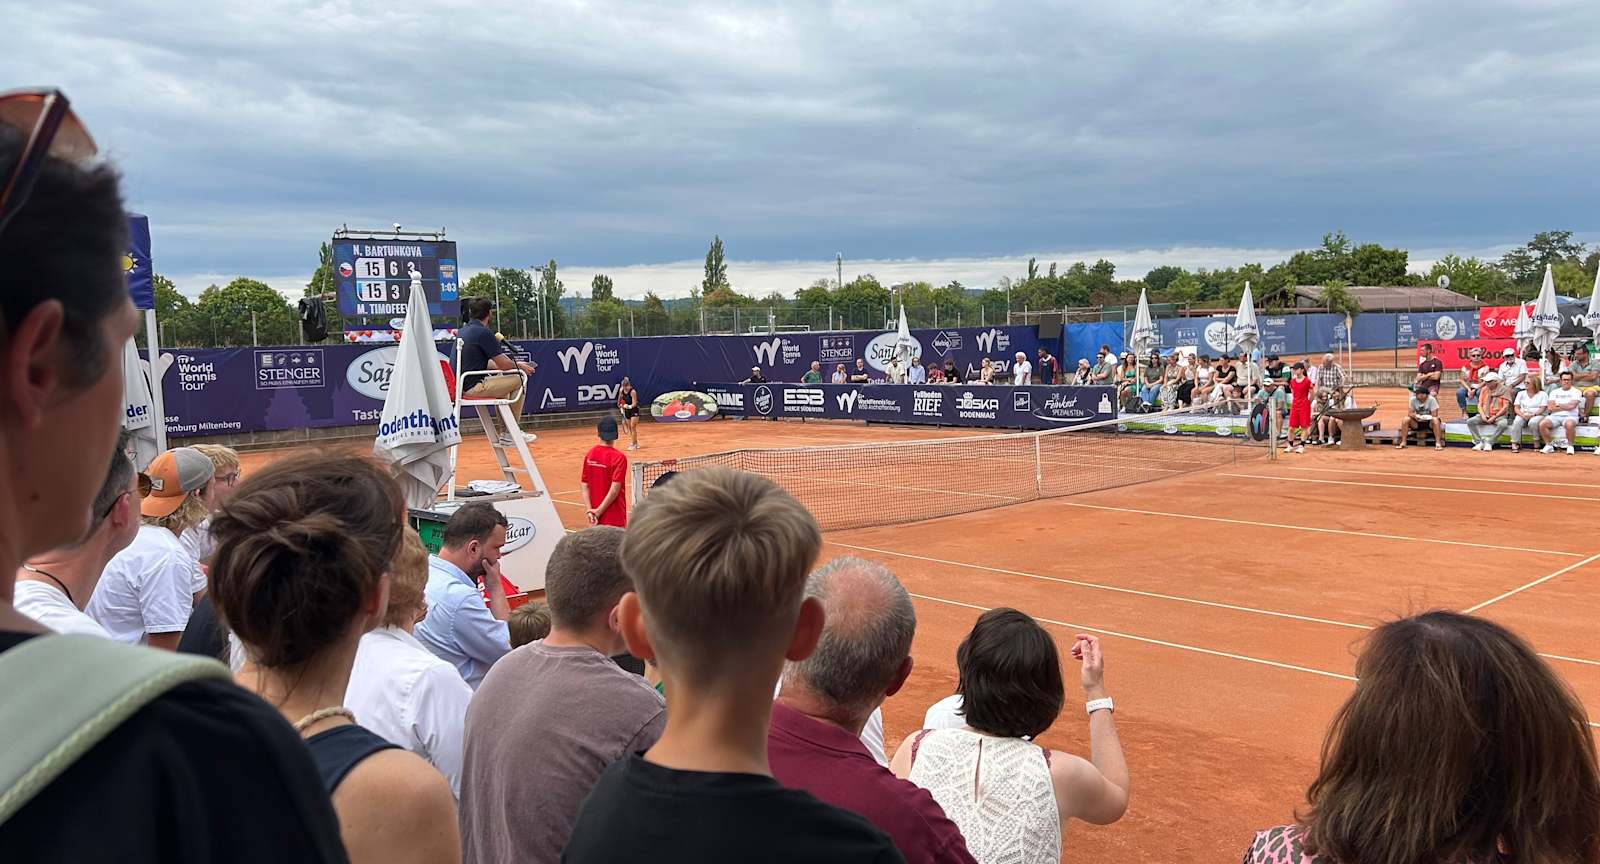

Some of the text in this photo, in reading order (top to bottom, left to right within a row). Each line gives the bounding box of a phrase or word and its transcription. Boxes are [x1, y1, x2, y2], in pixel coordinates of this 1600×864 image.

[353, 245, 422, 257] N. BARTUNKOVA
[365, 261, 415, 276] 15 6 3
[367, 283, 400, 299] 15 3
[441, 283, 456, 292] 1:03
[357, 304, 368, 314] M.
[595, 350, 618, 358] World
[821, 348, 852, 358] STENGER
[1457, 347, 1504, 359] Wlso
[179, 363, 214, 373] World
[179, 372, 217, 381] Tennis
[259, 368, 321, 380] STENGER
[180, 382, 206, 391] Tour
[578, 384, 620, 401] DSV
[784, 389, 824, 405] ESB
[913, 398, 942, 412] RIEF
[1044, 395, 1077, 410] Feinkost
[960, 411, 996, 419] BODENMAIS
[199, 421, 241, 430] Miltenberg
